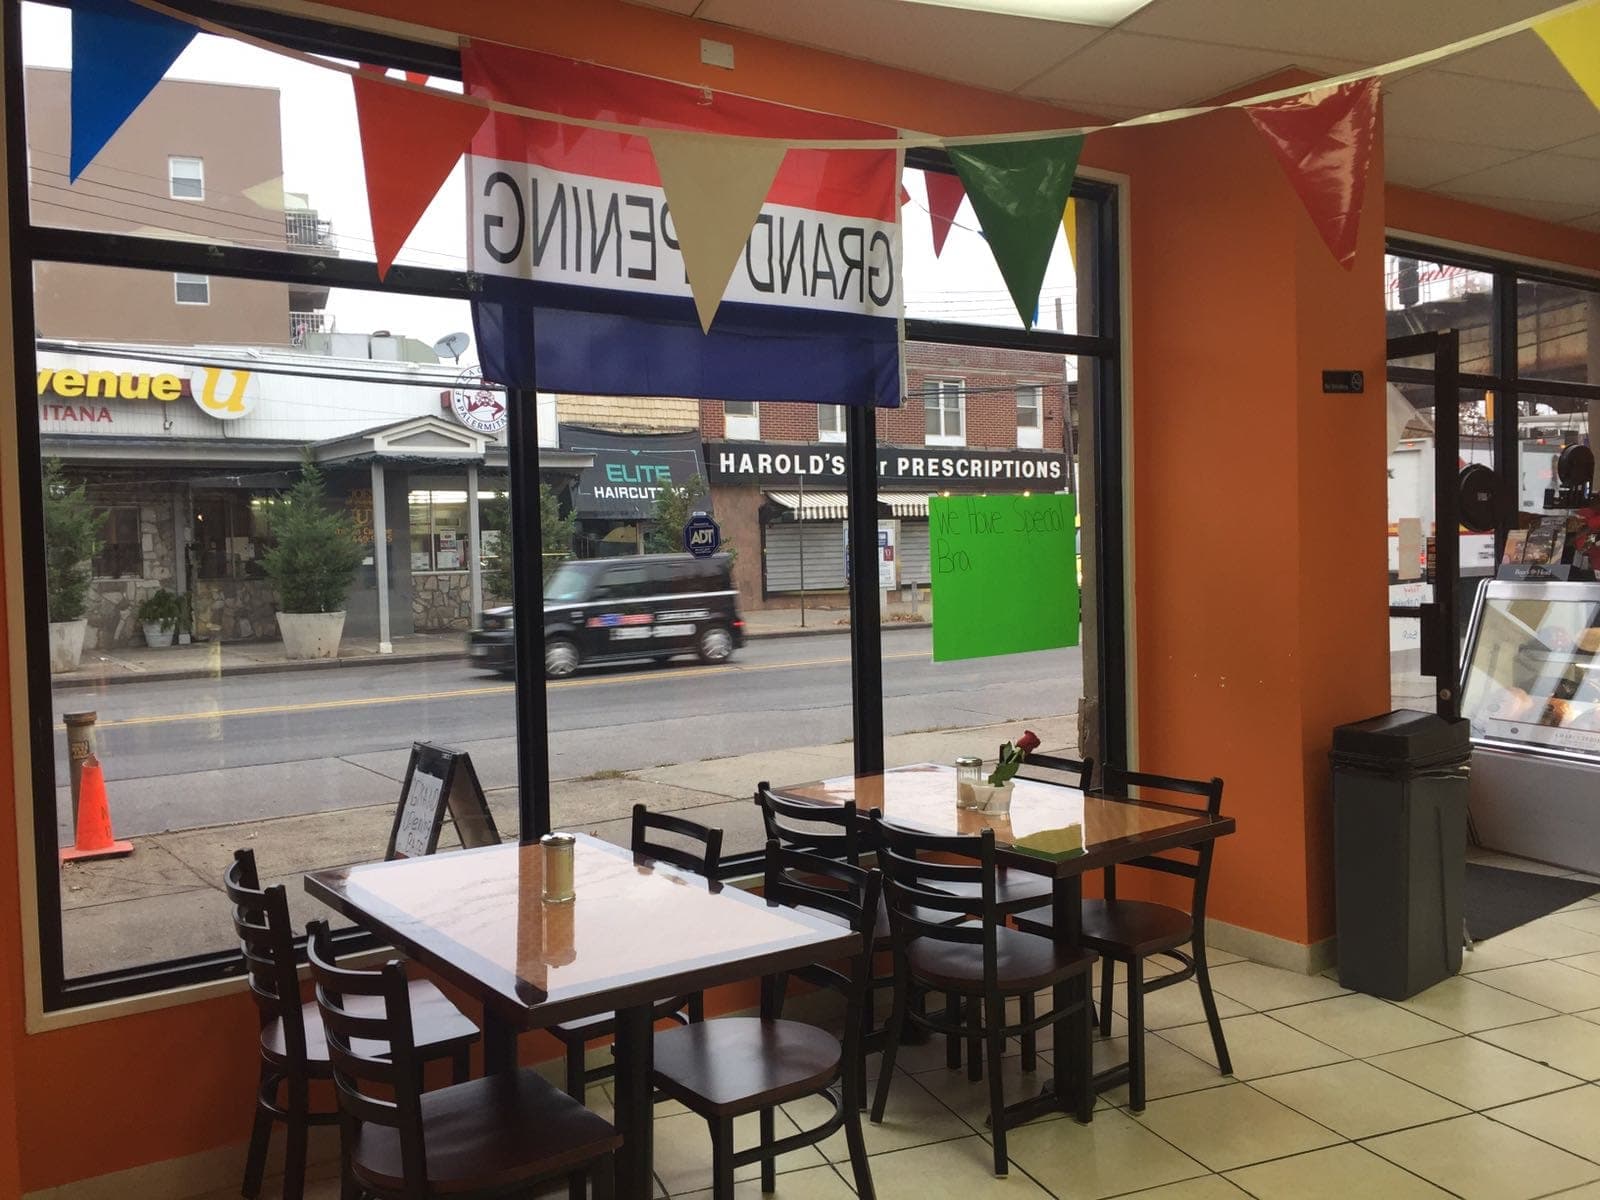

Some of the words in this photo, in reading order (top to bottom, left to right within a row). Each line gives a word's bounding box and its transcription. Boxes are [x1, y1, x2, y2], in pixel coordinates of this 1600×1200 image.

[37, 368, 182, 401] venue
[43, 404, 113, 423] ITANA
[606, 463, 672, 483] ELITE
[719, 452, 846, 476] HAROLD'S
[897, 457, 1061, 479] PRESCRIPTIONS
[934, 498, 961, 536] We
[691, 529, 714, 545] ADT
